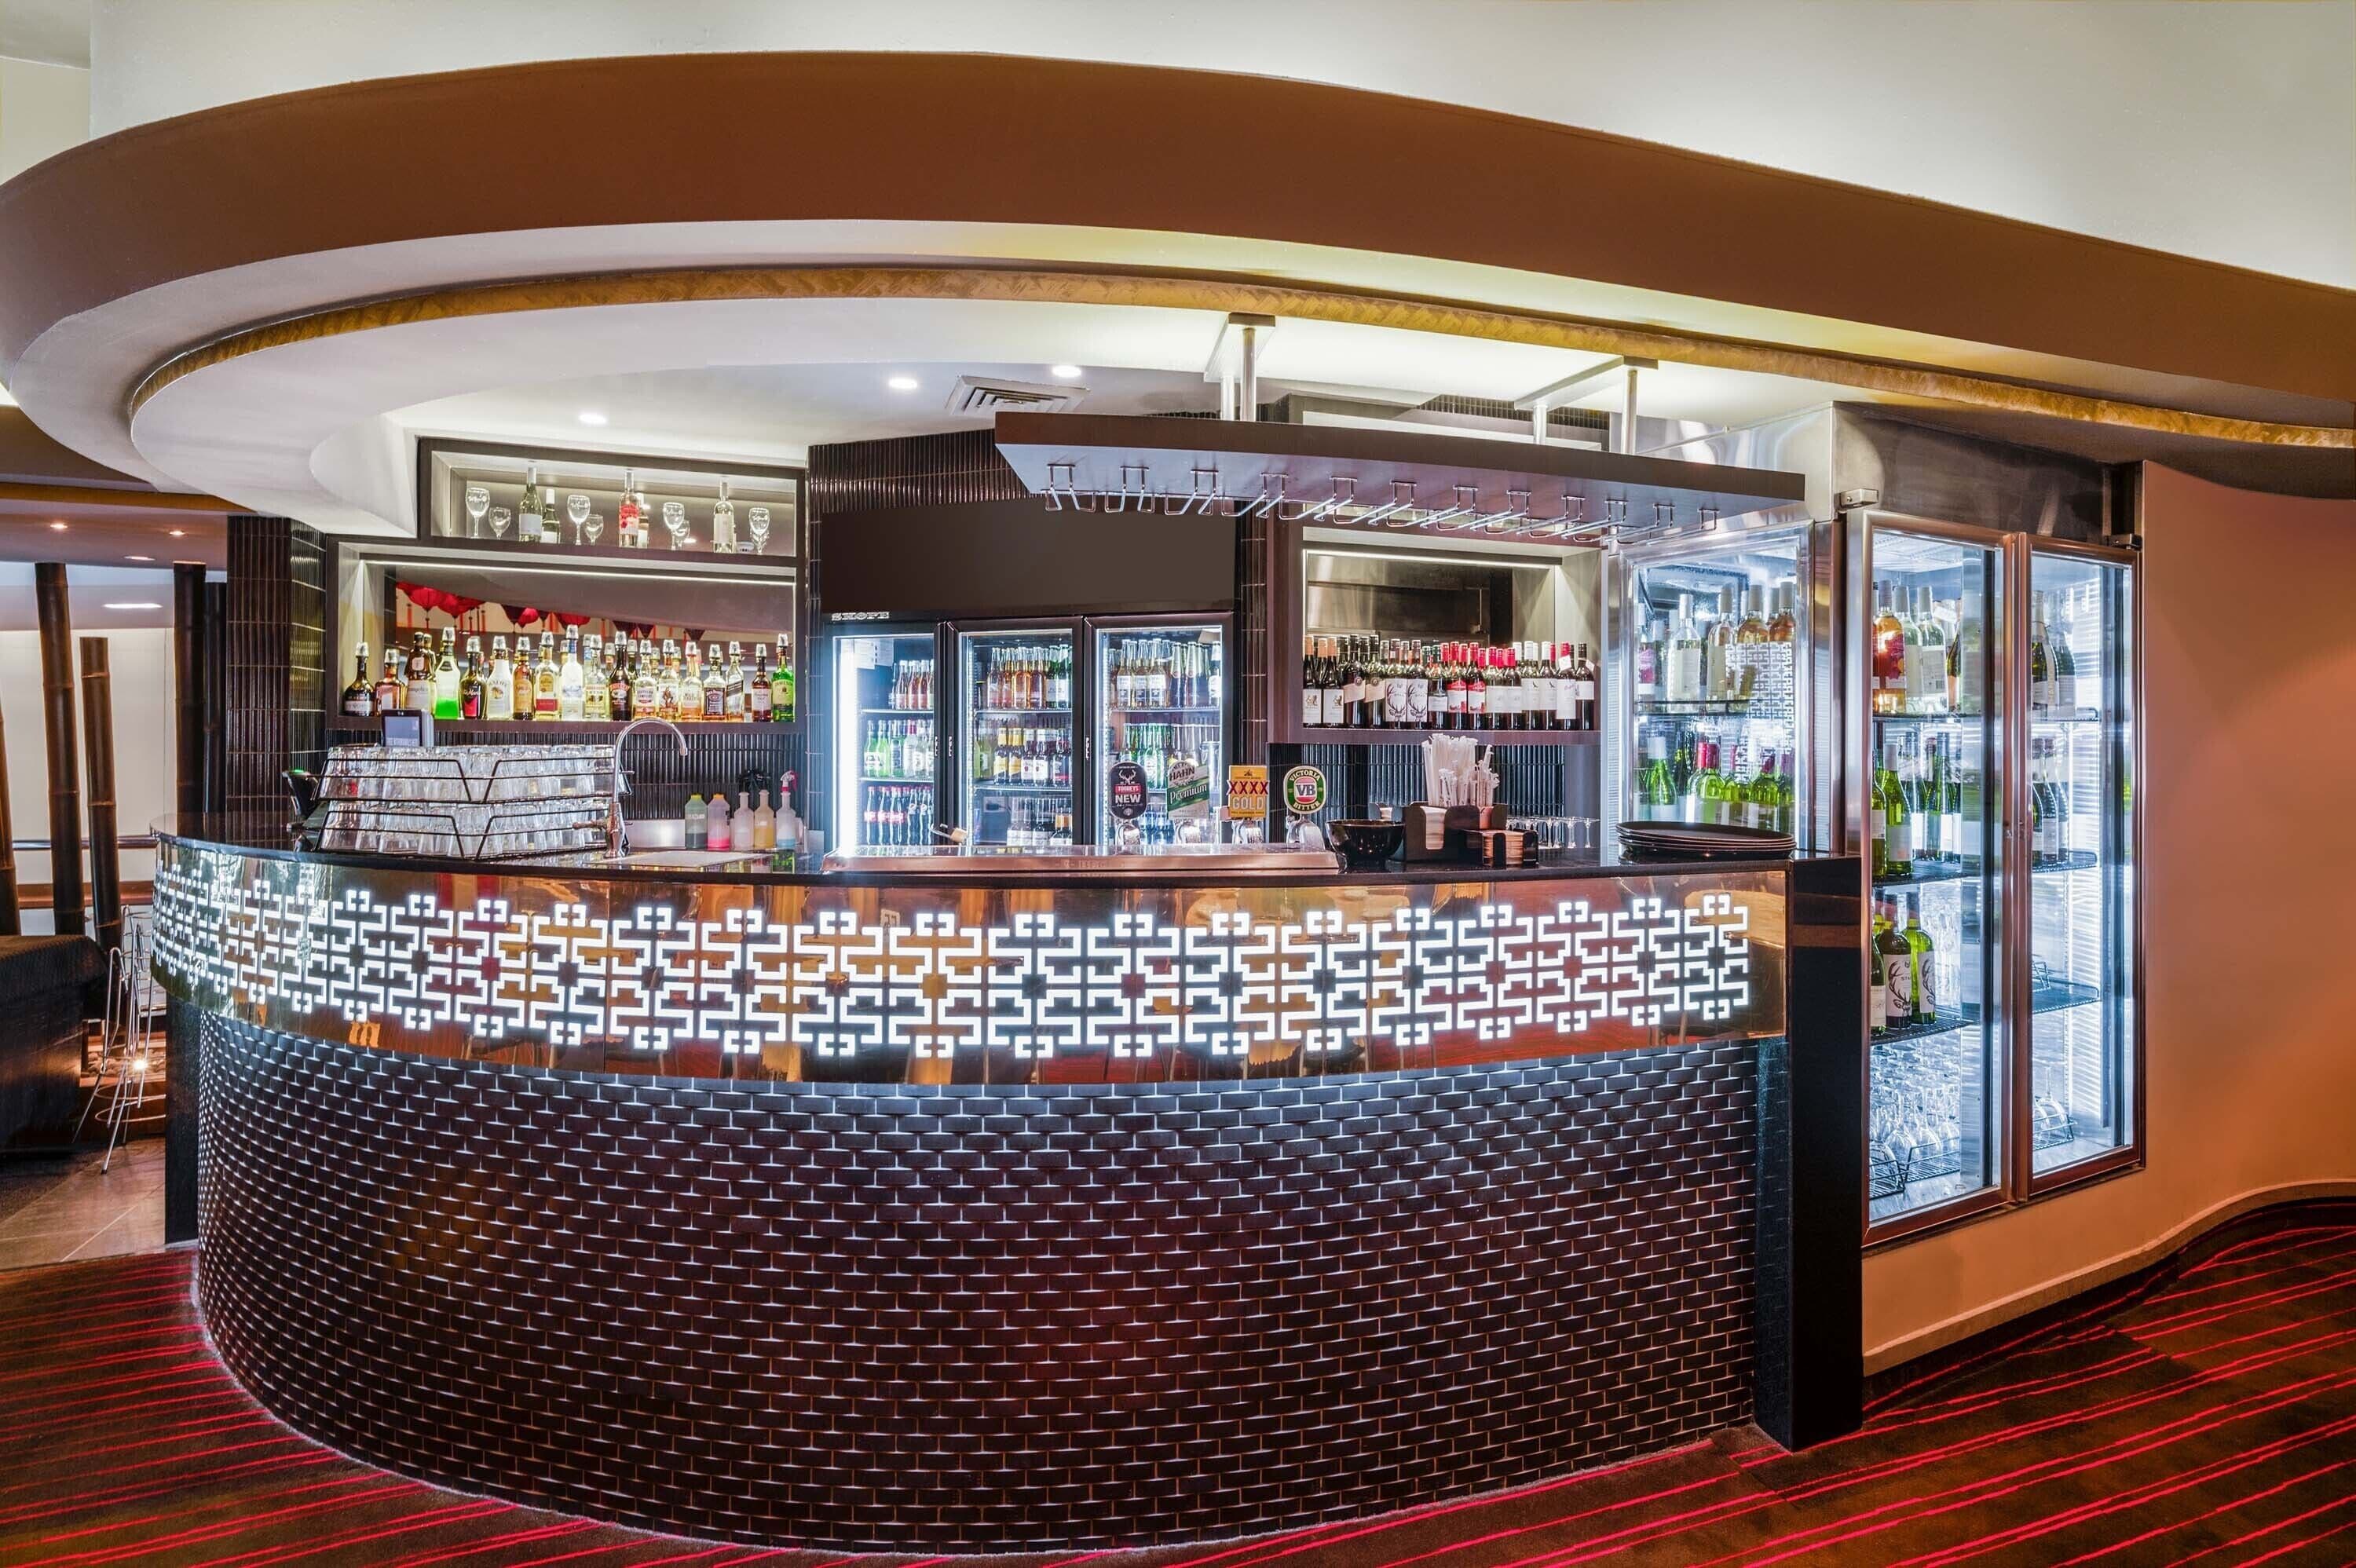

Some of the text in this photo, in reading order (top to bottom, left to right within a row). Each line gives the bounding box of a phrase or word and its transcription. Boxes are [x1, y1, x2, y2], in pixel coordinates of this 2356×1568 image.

[1169, 768, 1194, 781] HAHN
[1289, 769, 1321, 781] VICTORIA
[1227, 780, 1270, 795] XXXX
[1296, 784, 1315, 796] VB
[1115, 795, 1141, 803] NEW
[1169, 784, 1207, 804] Premium
[1232, 796, 1264, 811] GOLD
[1293, 802, 1320, 810] BITTER
